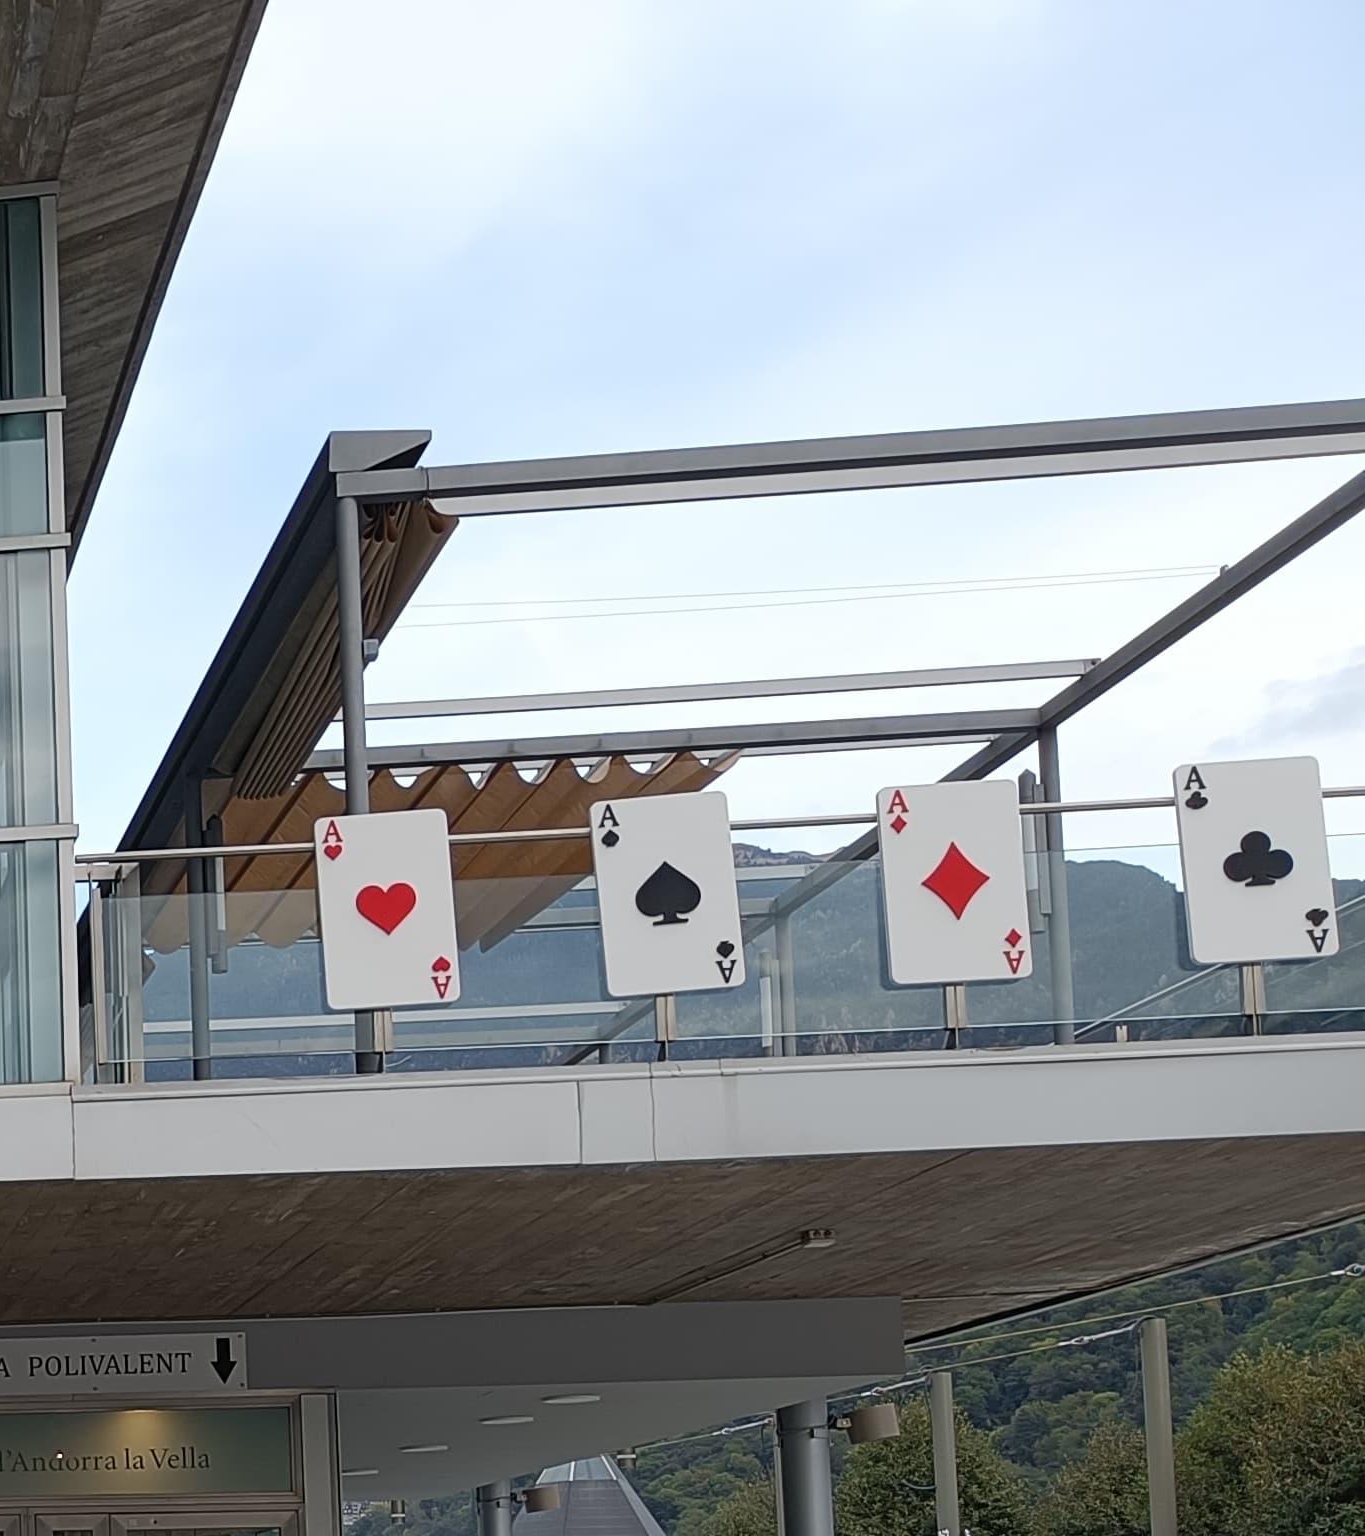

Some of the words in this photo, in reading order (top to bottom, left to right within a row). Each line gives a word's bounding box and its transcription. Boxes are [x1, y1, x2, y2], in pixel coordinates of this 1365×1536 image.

[1184, 766, 1206, 790] A
[887, 789, 909, 814] A
[598, 803, 620, 828] A
[322, 819, 343, 843] A
[28, 1351, 193, 1378] POLIVALENT
[124, 1446, 144, 1470] la
[149, 1446, 211, 1469] Vella
